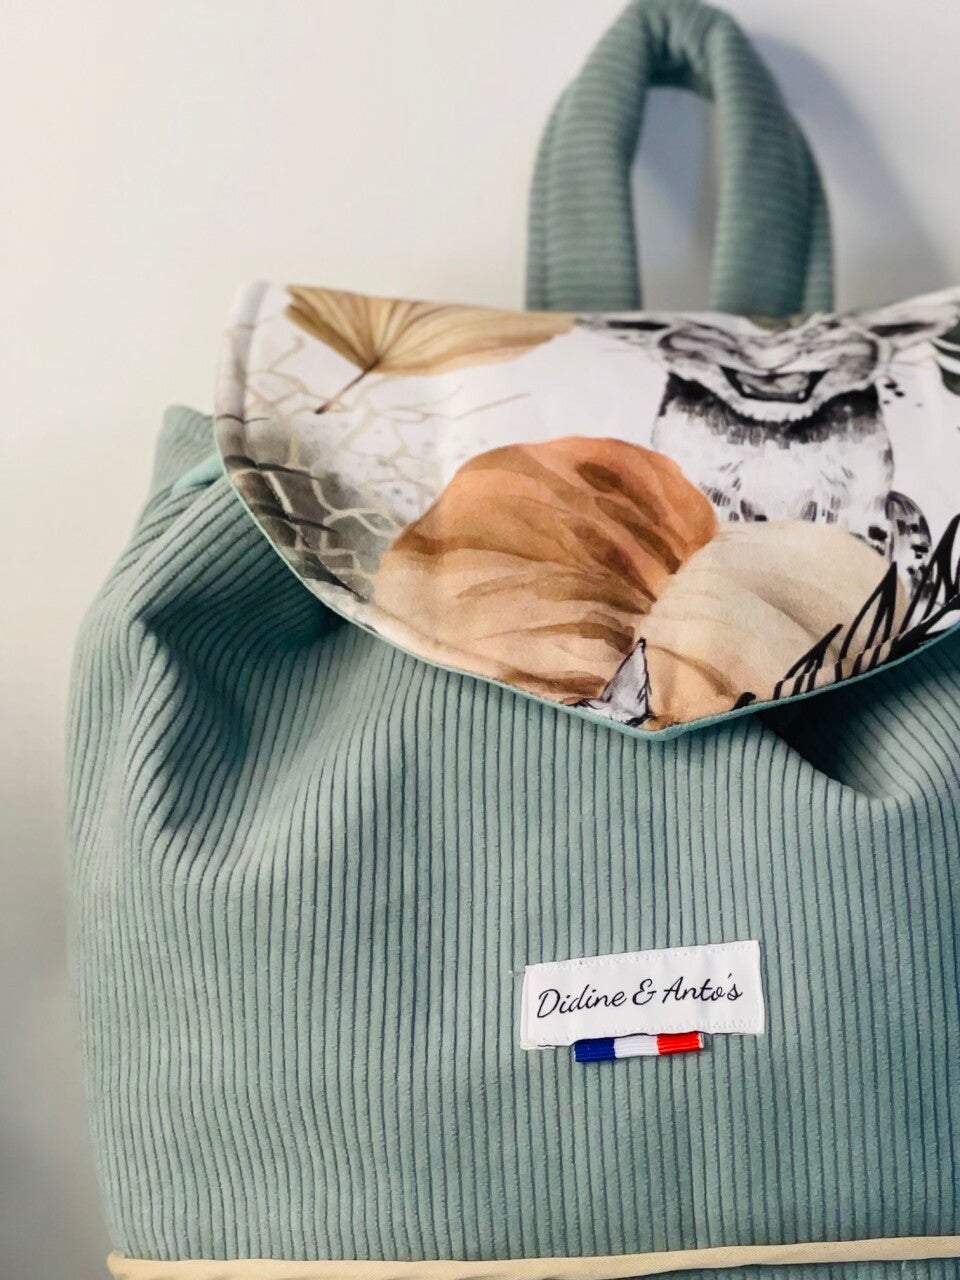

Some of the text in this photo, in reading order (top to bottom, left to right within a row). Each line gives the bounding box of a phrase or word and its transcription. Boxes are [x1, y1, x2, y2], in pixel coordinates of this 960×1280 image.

[536, 973, 743, 1019] Didine & Anto's
